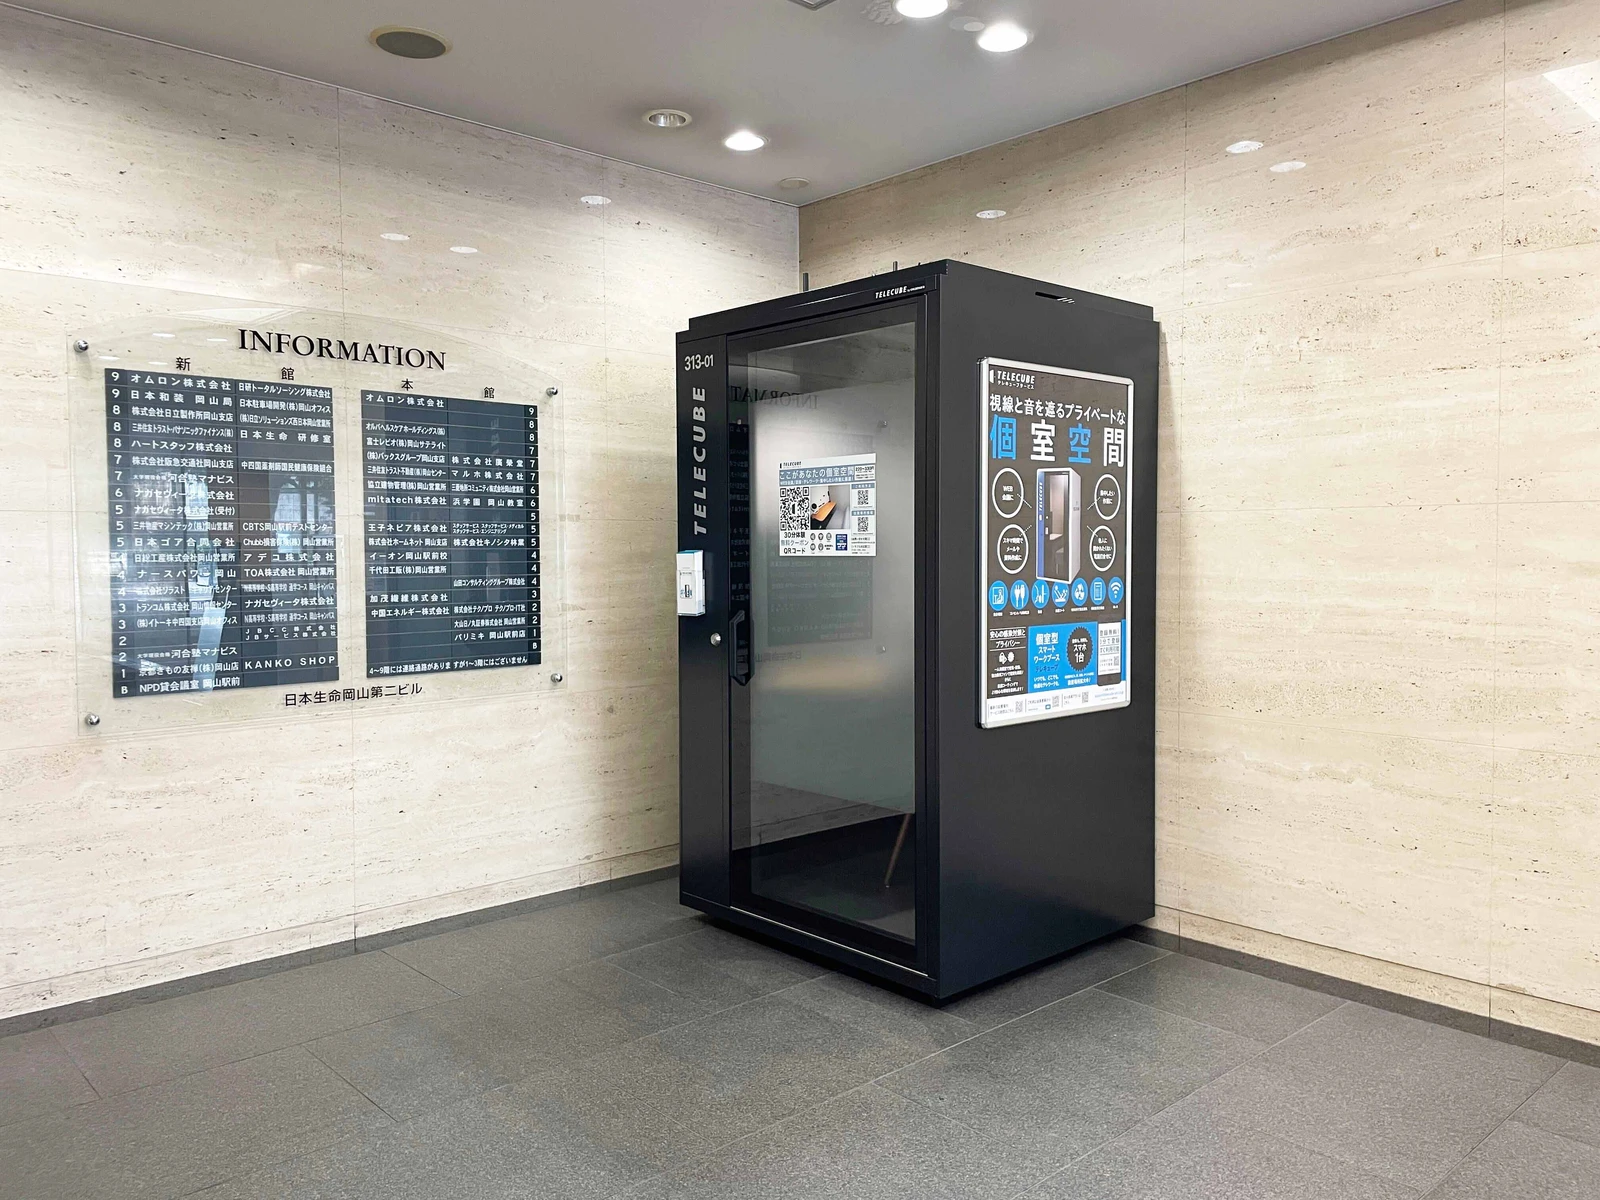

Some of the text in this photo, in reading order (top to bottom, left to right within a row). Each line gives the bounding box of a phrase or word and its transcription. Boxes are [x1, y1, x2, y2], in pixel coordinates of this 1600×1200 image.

[876, 286, 907, 299] TELECUBE
[238, 328, 446, 370] INFORMATION
[176, 357, 294, 380] 新 館
[684, 354, 714, 371] 313-01
[997, 371, 1035, 384] TELECUBE
[111, 372, 330, 398] 9 オムロン株式会社 日研トータルソーシング株式会社
[401, 379, 494, 398] 本 館
[112, 389, 120, 398] 9
[131, 390, 184, 403] 日本和装
[195, 395, 232, 406] 岡山局
[366, 394, 444, 408] オムロン株式会社
[113, 405, 120, 414] 8
[132, 406, 233, 421] 株式会社日立製作所岡山支店
[990, 394, 1126, 425] 視線と音を遮るプライベートな
[114, 422, 121, 431] 8
[240, 430, 288, 440] 日本生命
[298, 433, 331, 443] 研修室
[114, 438, 232, 453] 8 ハートスタッフ株式会社
[990, 414, 1124, 467] 個室空間
[114, 455, 122, 464] 7
[132, 456, 234, 468] 株式会社阪急交通社岡山支店
[693, 387, 707, 536] TELECUBE
[115, 471, 122, 480] 7
[780, 466, 854, 479] ここがあなたの個室空間
[115, 488, 123, 497] 6
[368, 495, 447, 505] mitatech株式会社
[453, 498, 480, 506] 浜学園
[488, 499, 524, 507] 岡山教室
[116, 505, 123, 514] 5
[116, 521, 123, 530] 5
[117, 538, 124, 547] 5
[369, 538, 423, 546] 株式会社ホームネット
[244, 553, 334, 562] アデコ株式会社
[370, 551, 536, 560] イーオン岡山駅前校 4
[244, 568, 296, 577] TOA株式会社
[298, 568, 334, 576] 岡山営業所
[531, 564, 536, 572] 4
[532, 590, 537, 598] 3
[119, 604, 126, 612] 3
[245, 597, 334, 608] ナガセヴィータ株式会社
[371, 607, 450, 617] 中国エネルギー株式会社
[532, 603, 537, 611] 2
[119, 620, 126, 629] 3
[532, 616, 537, 624] 2
[119, 636, 127, 645] 2
[490, 630, 525, 639] 岡山駅前店
[1036, 632, 1058, 645] 個室型
[1039, 645, 1055, 654] スマート
[1074, 643, 1087, 651] スマホ
[119, 653, 127, 661] 2
[171, 647, 237, 658] 河合塾マナビス
[1034, 654, 1060, 664] ワークブース
[1075, 652, 1084, 663] 1台
[245, 659, 292, 670] KANKO
[300, 656, 335, 666] SHOP
[121, 677, 240, 694] B NPD貸会議室 岡山駅前
[285, 682, 423, 706] 日本生命岡山第二ビル
